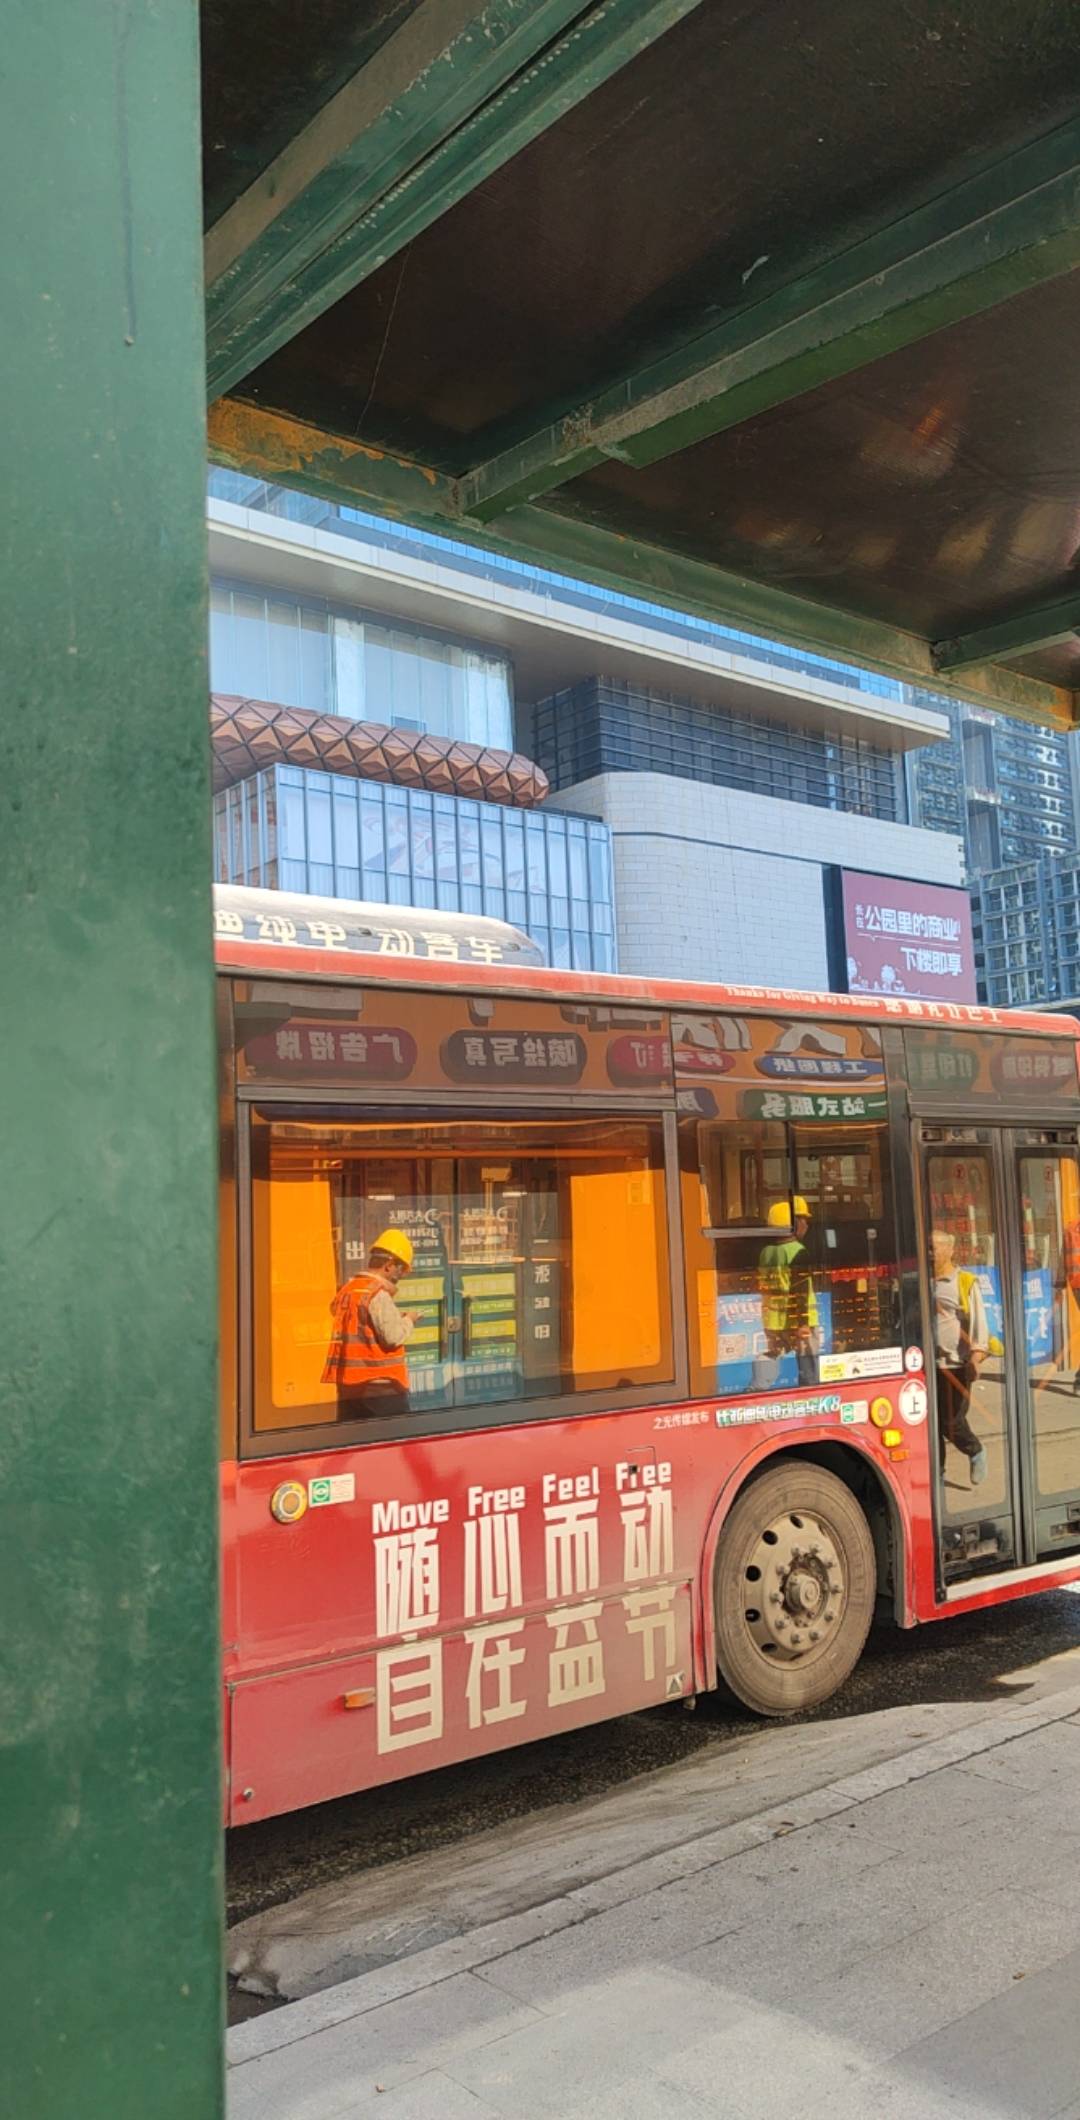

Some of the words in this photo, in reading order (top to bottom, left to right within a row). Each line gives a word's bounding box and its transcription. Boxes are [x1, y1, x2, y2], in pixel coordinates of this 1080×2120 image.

[865, 905, 961, 942] 公园里的商业
[900, 946, 963, 976] 下楼即享
[725, 986, 765, 998] Thanks
[766, 989, 781, 1001] for
[782, 991, 818, 1004] Giving
[372, 1499, 450, 1534] Move
[467, 1486, 526, 1516] Free
[542, 1467, 601, 1503] Feel
[615, 1461, 672, 1490] Free
[373, 1488, 674, 1639] 随心而动
[375, 1585, 677, 1756] 自在益节
